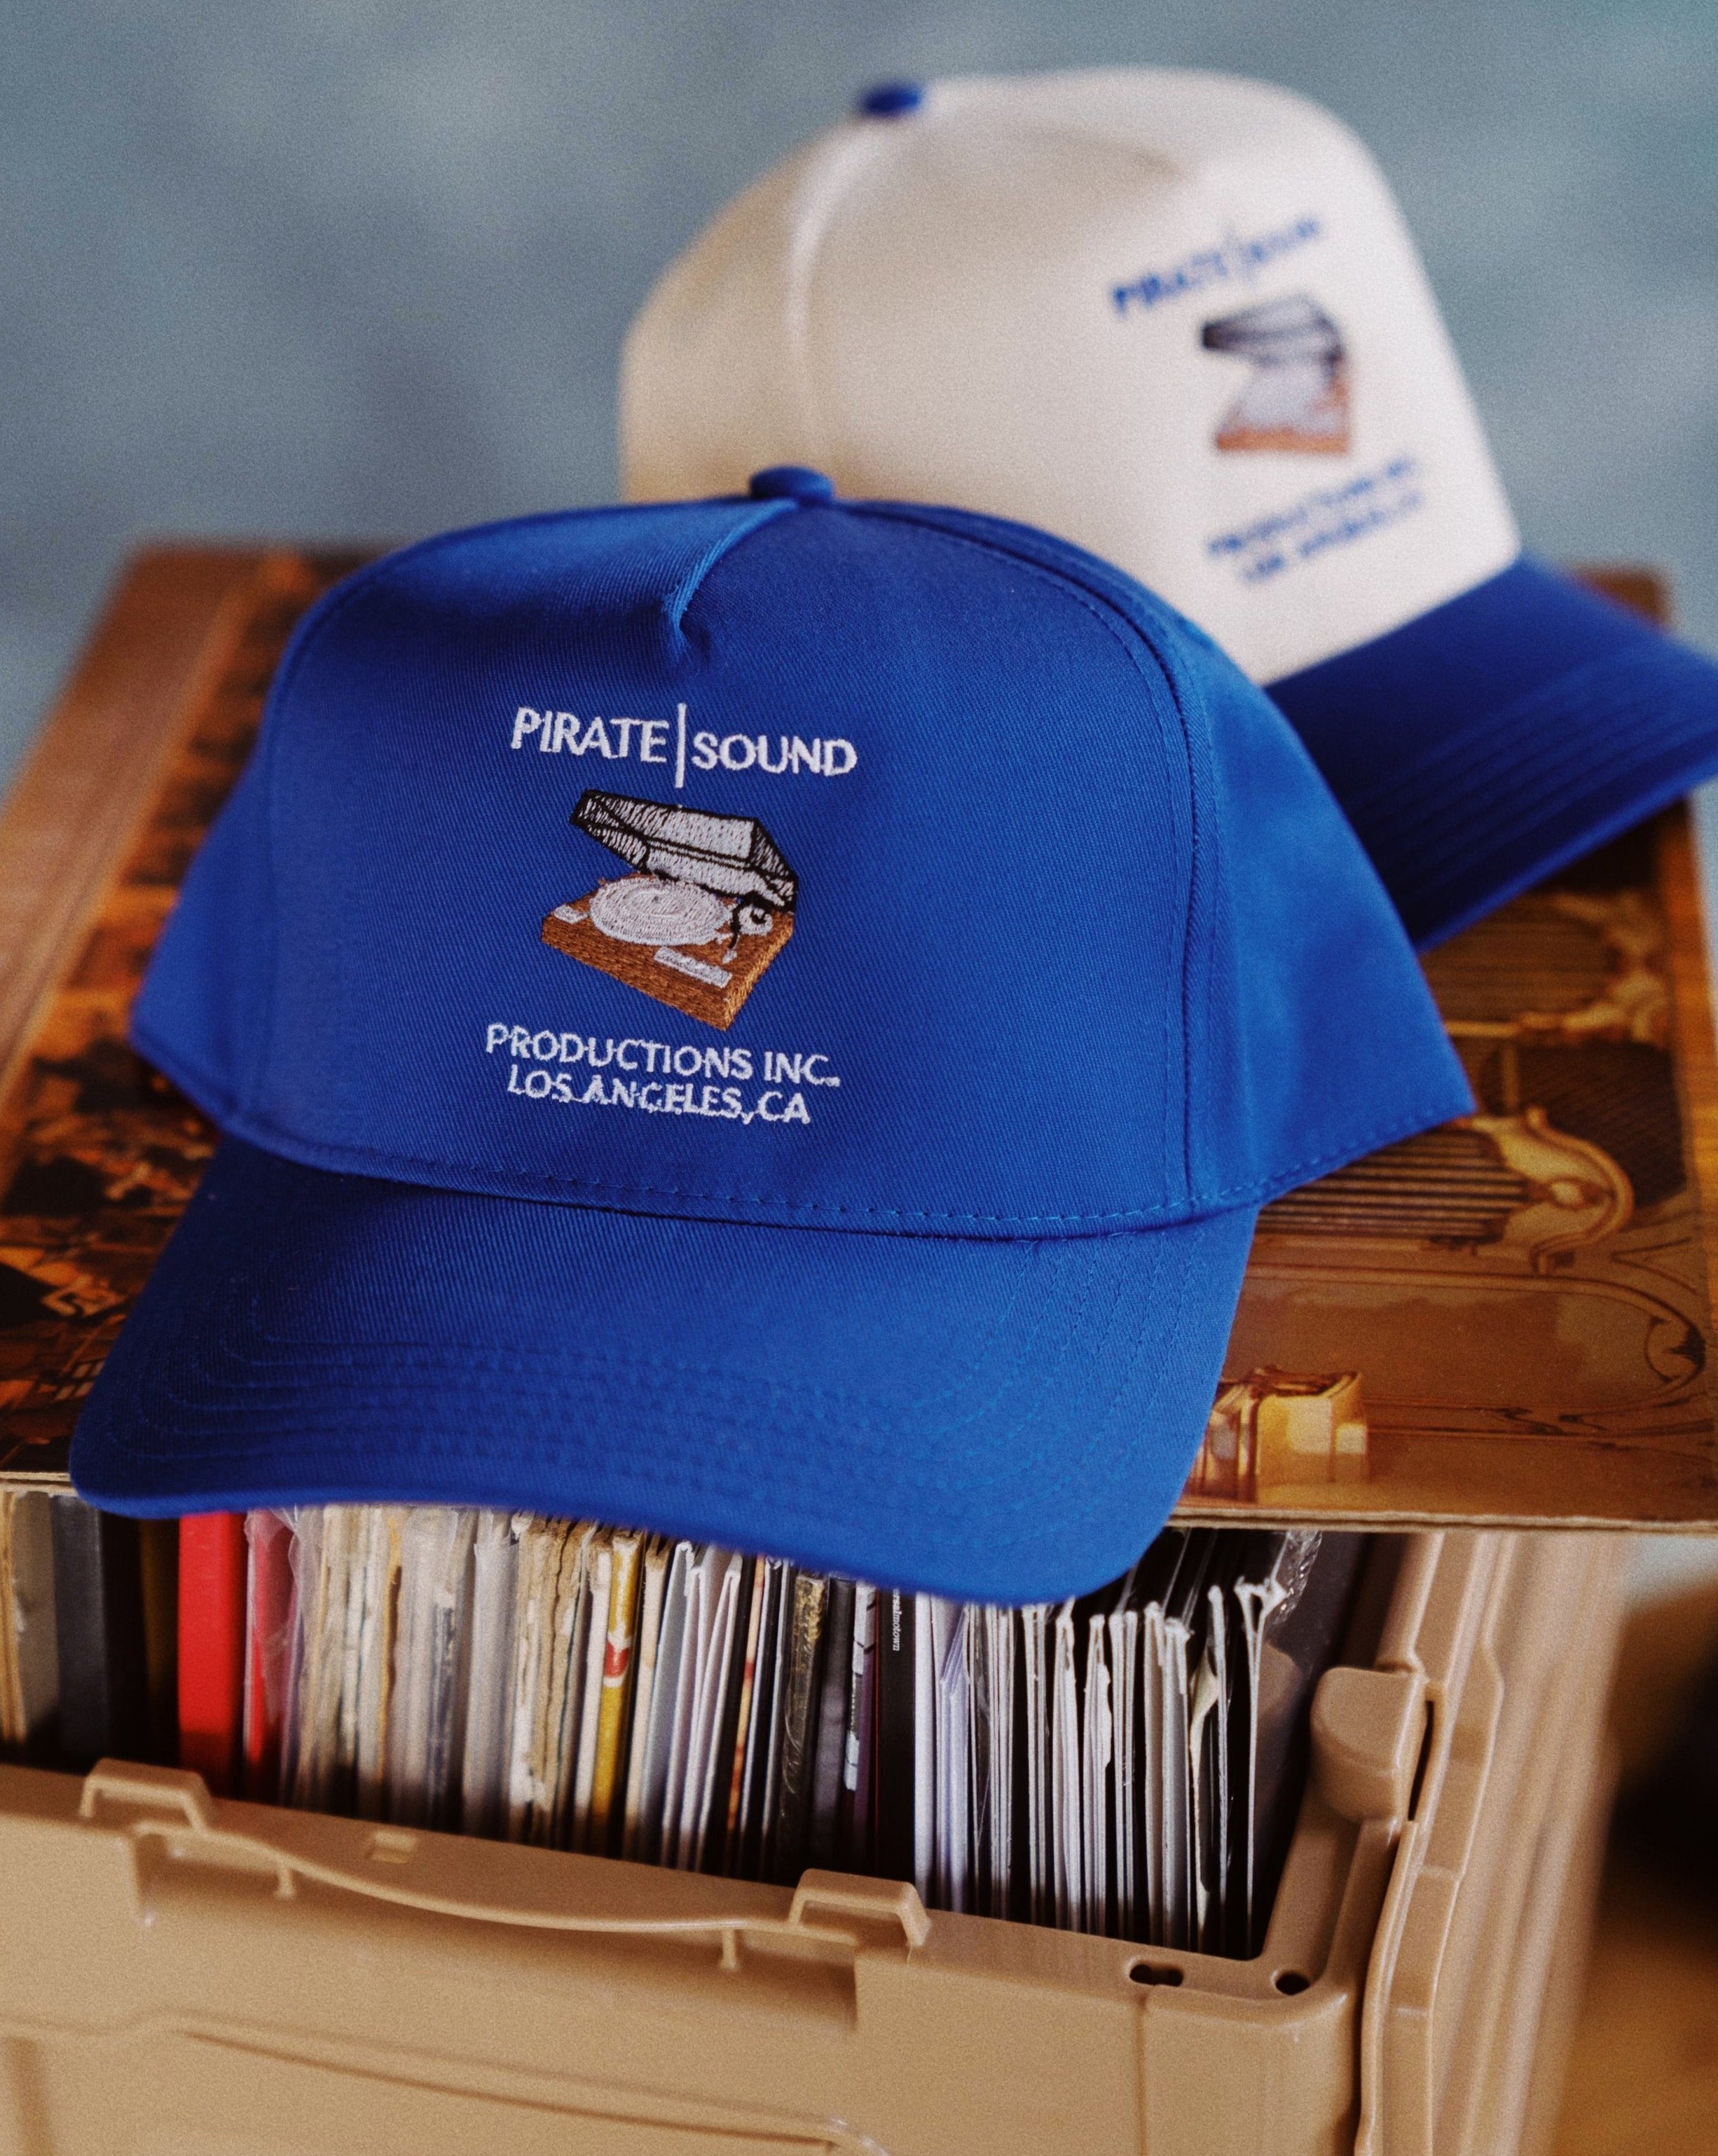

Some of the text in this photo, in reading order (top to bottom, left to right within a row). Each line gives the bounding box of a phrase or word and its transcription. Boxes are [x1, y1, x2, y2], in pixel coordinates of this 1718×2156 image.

[511, 706, 858, 777] PIRATE SOUND
[486, 1022, 840, 1087] PRODUCTIONS INC.
[507, 1064, 572, 1104] LOS
